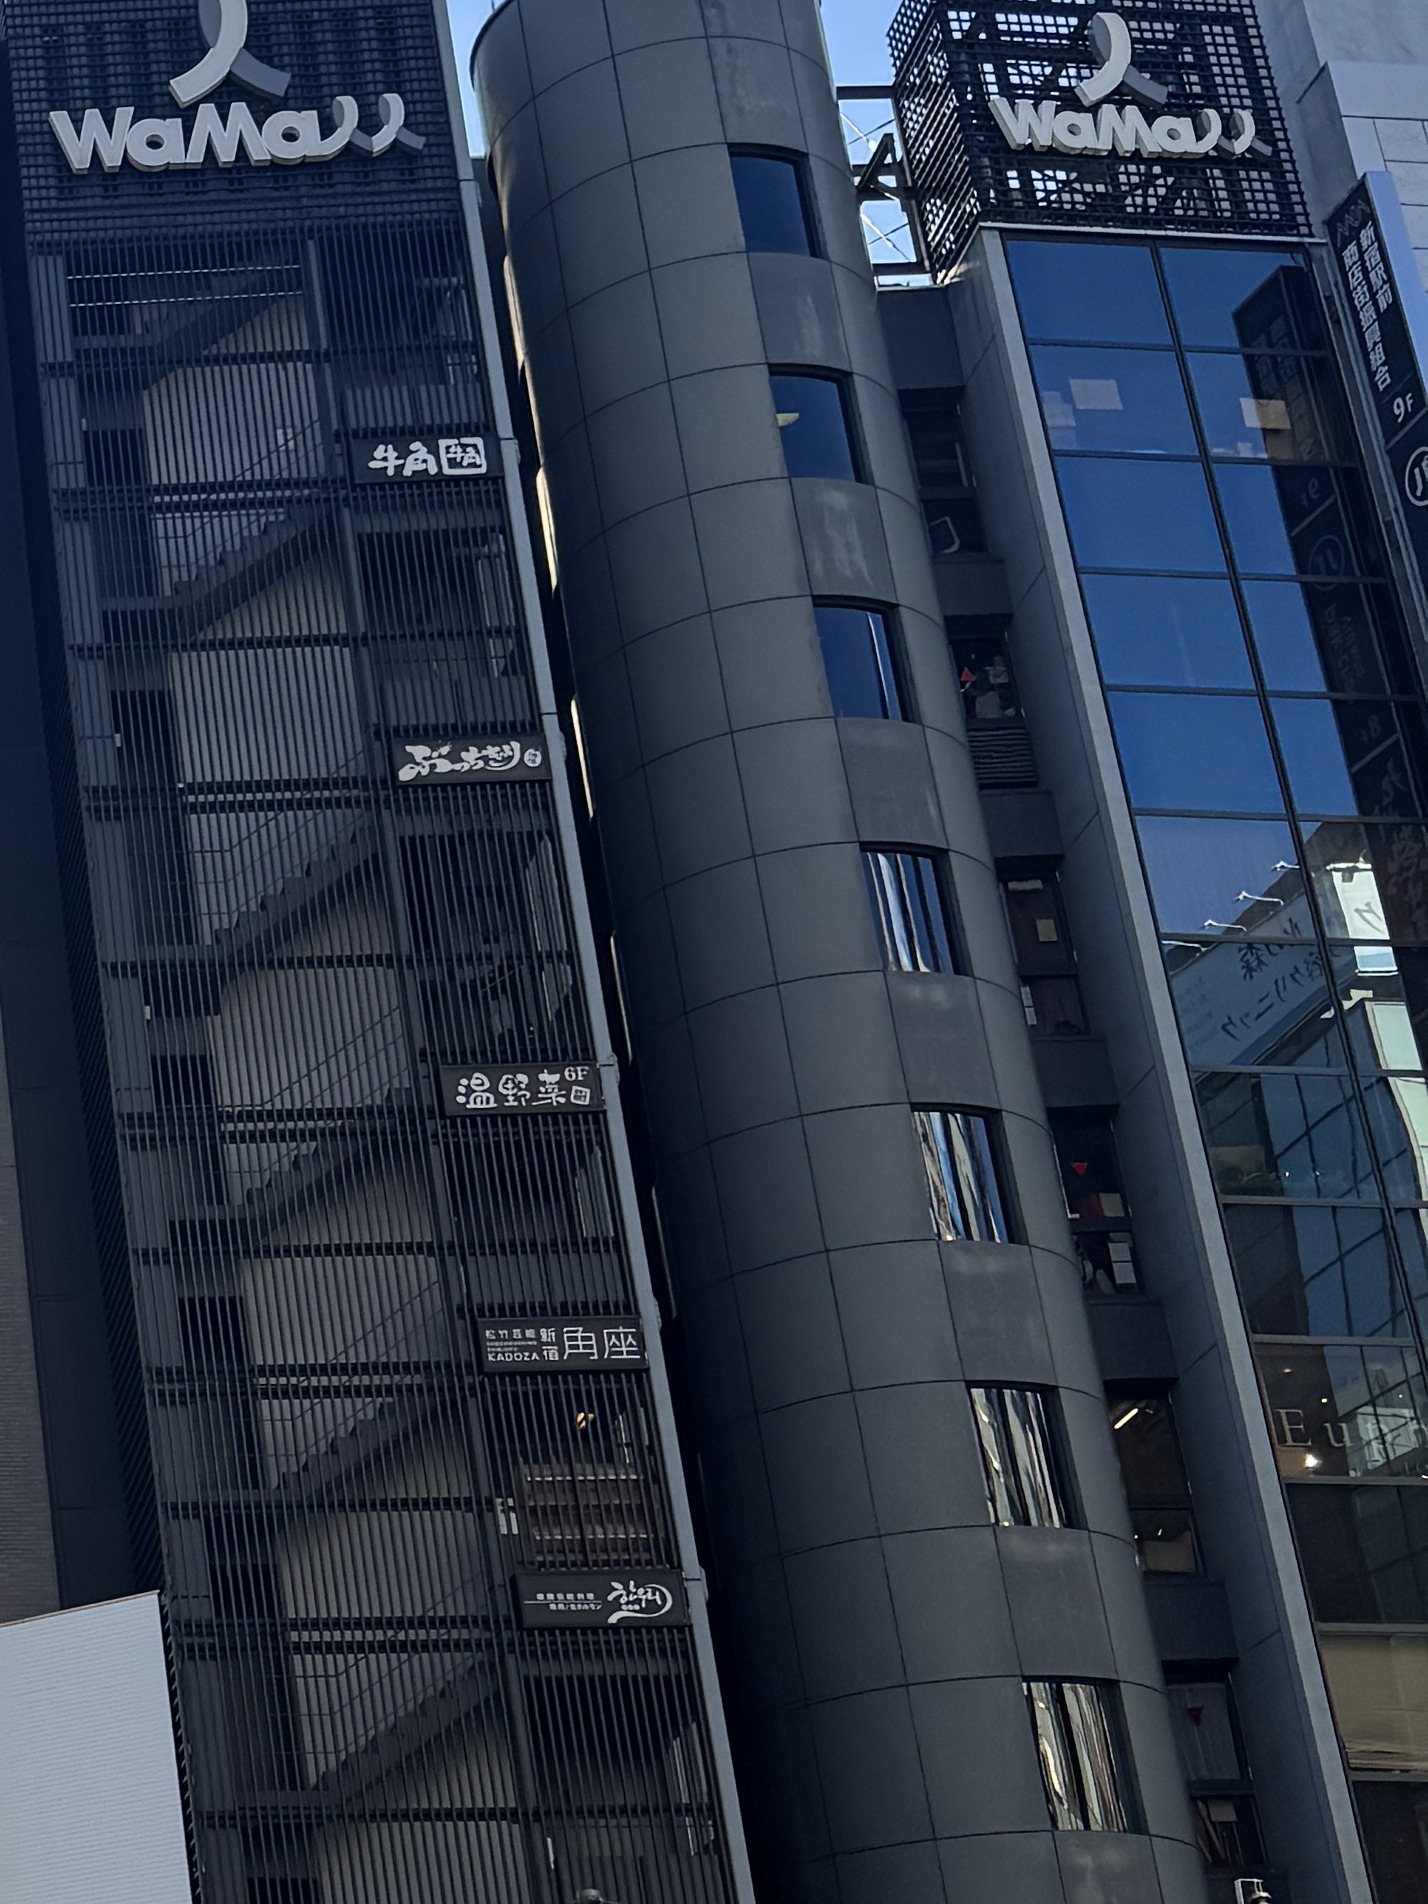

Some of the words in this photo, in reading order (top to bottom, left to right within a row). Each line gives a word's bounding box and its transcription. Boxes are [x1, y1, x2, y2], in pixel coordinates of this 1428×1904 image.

[1393, 393, 1414, 423] 9F
[368, 442, 437, 476] 牛角
[564, 1066, 590, 1081] 6F
